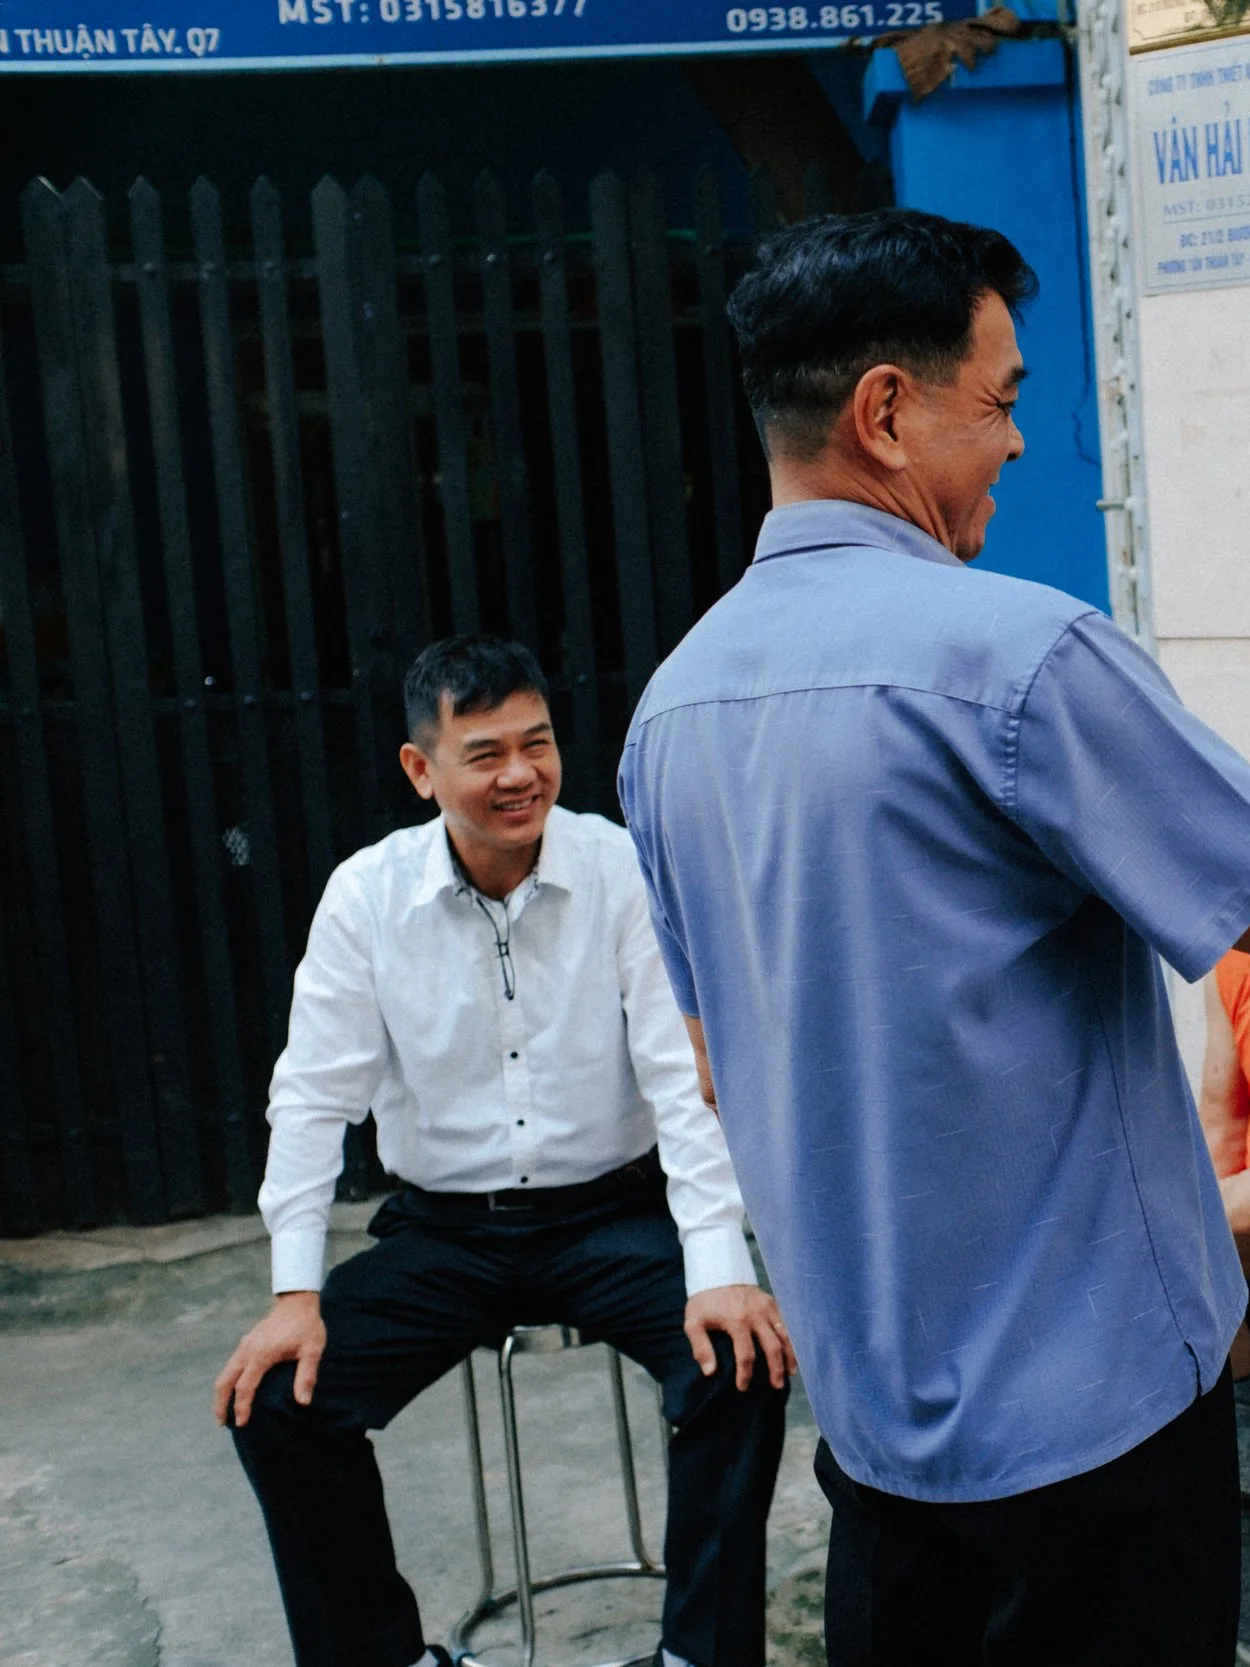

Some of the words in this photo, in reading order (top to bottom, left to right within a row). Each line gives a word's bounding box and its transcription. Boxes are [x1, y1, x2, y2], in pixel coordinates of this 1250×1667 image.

[278, 0, 370, 25] MST:
[726, 2, 944, 33] 0938.861.225
[14, 23, 117, 59] THUẬN
[186, 27, 220, 58] Q7
[1205, 100, 1243, 178] HẢI
